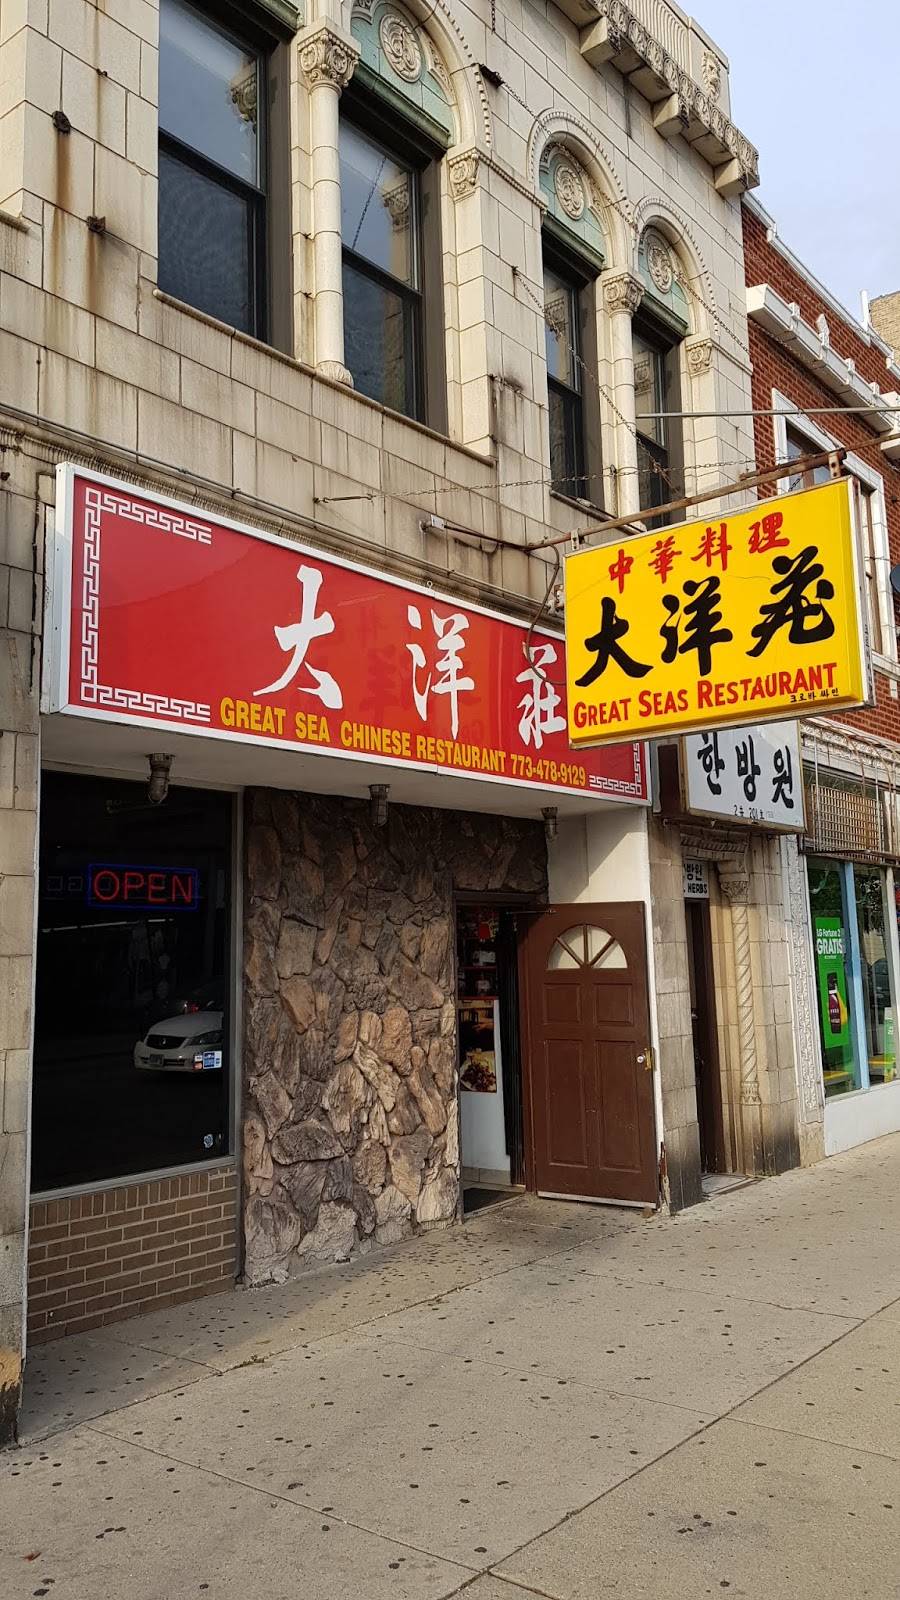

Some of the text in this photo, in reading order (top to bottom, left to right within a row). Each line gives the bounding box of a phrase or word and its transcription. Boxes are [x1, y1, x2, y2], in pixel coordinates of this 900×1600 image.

[608, 511, 791, 594] 中華料理
[573, 662, 837, 729] GREAT SEAS RESTAURANT
[220, 697, 586, 787] GREAT SEA CHINESE RESTAURANT 773-478-9129
[697, 732, 794, 809] 한방원
[93, 870, 193, 904] OPEN
[687, 882, 707, 894] HERBS
[817, 938, 844, 955] GRATIS
